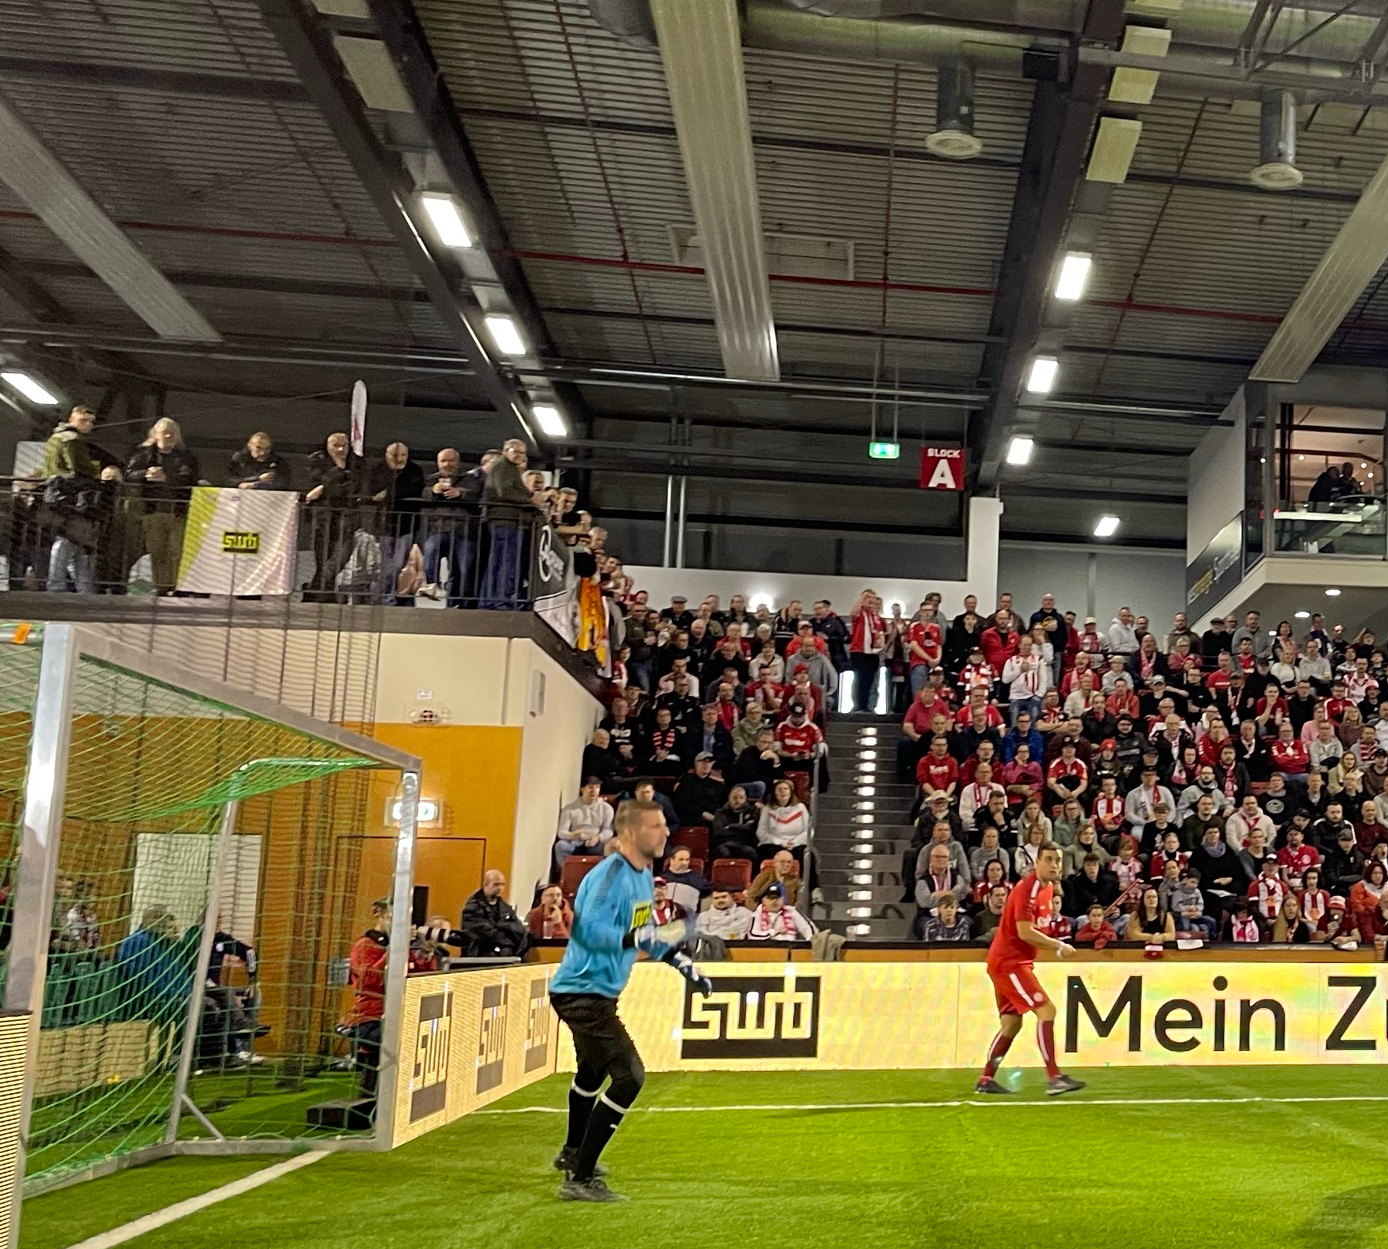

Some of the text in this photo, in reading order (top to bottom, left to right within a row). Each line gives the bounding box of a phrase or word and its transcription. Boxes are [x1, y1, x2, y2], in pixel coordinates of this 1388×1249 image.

[927, 448, 961, 458] BLOCK
[928, 459, 956, 489] A
[672, 965, 814, 1040] swb
[1065, 975, 1285, 1053] Mein
